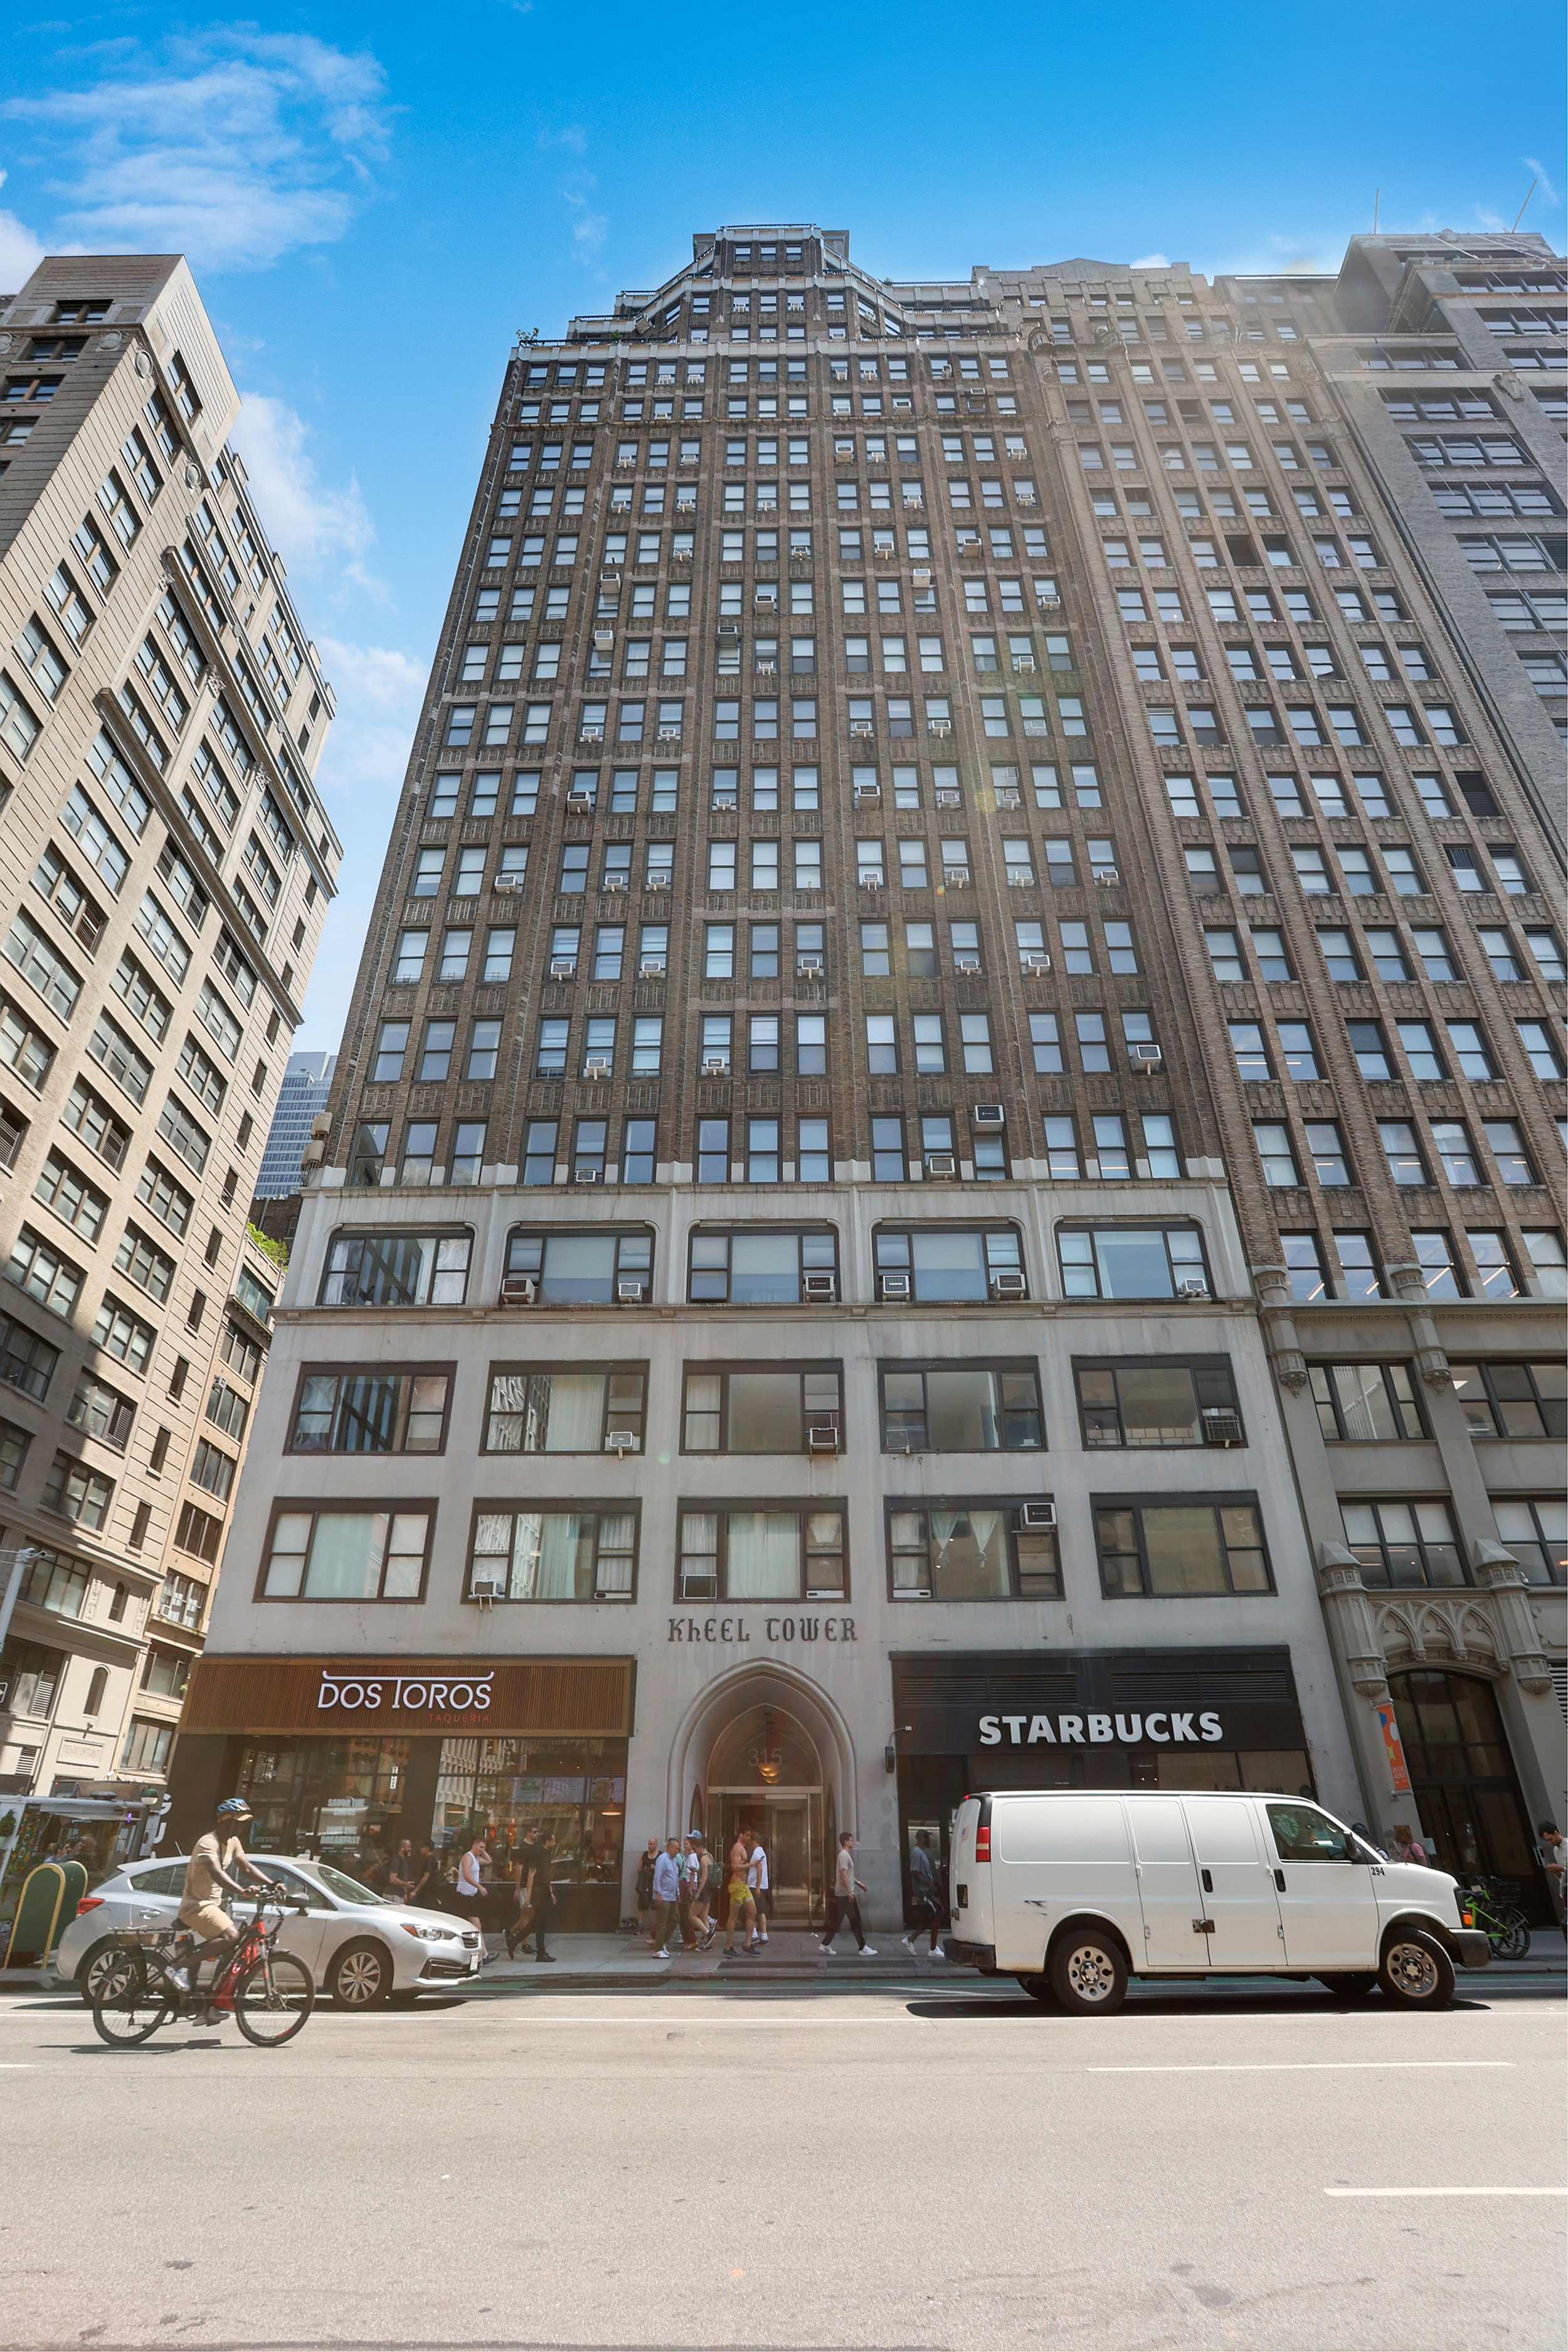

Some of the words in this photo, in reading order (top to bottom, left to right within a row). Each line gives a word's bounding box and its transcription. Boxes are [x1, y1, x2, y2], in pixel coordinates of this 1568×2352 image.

[765, 1618, 858, 1642] TOWER
[318, 1683, 383, 1709] DOS
[391, 1670, 494, 1709] TOROS
[429, 1713, 490, 1724] TAQUERIA
[978, 1712, 1224, 1745] STARBUCKS
[748, 1748, 781, 1767] 315
[352, 1798, 364, 1807] THE
[320, 1836, 360, 1844] BREAKFAST
[1371, 1867, 1385, 1876] 294
